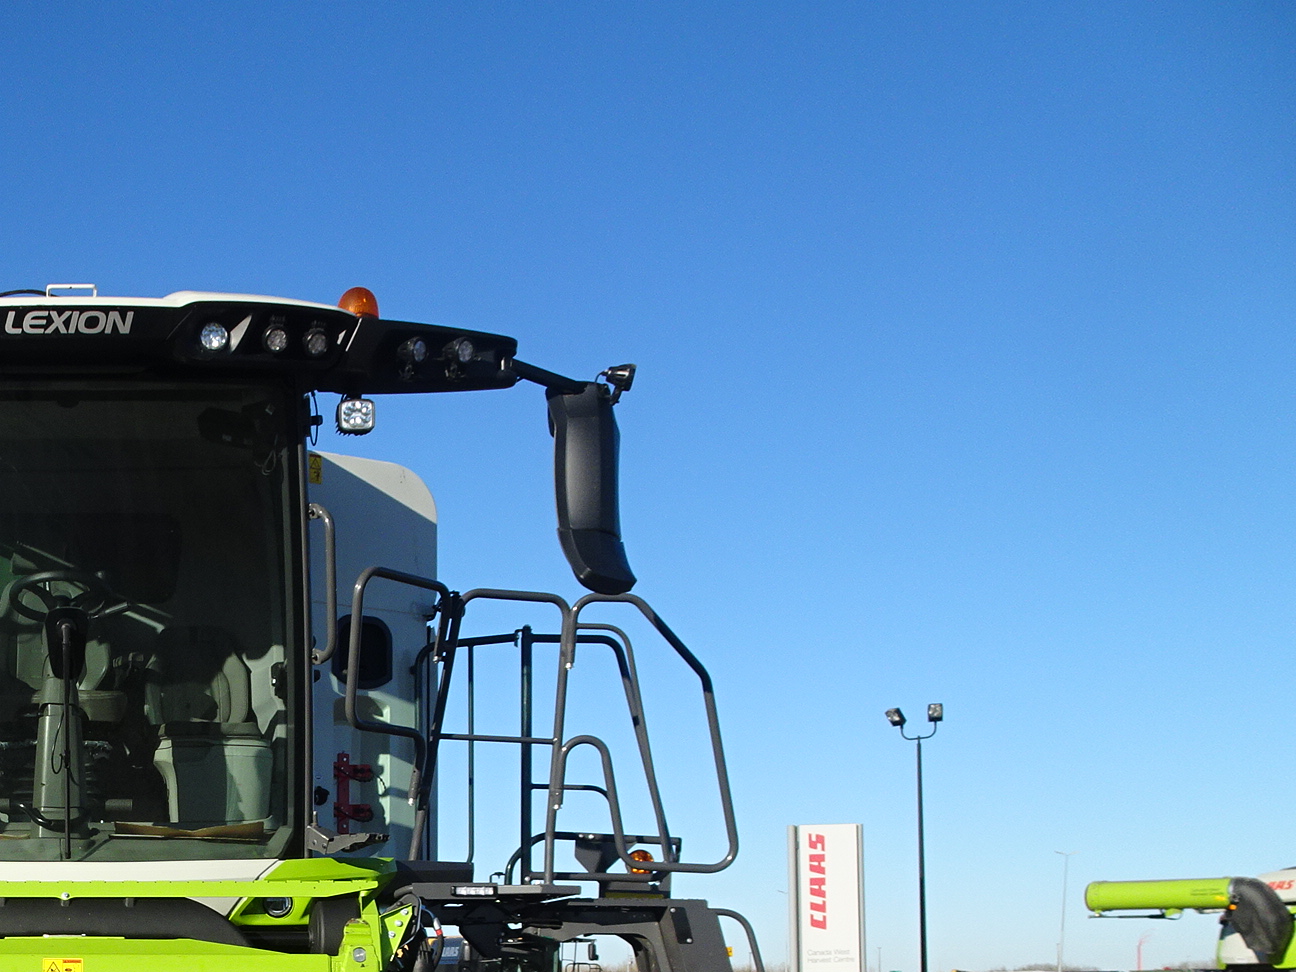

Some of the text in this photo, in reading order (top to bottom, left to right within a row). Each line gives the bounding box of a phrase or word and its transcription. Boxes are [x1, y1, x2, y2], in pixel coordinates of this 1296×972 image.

[5, 311, 134, 334] LEXION
[808, 833, 827, 930] CLAAS
[1266, 880, 1295, 890] AAS
